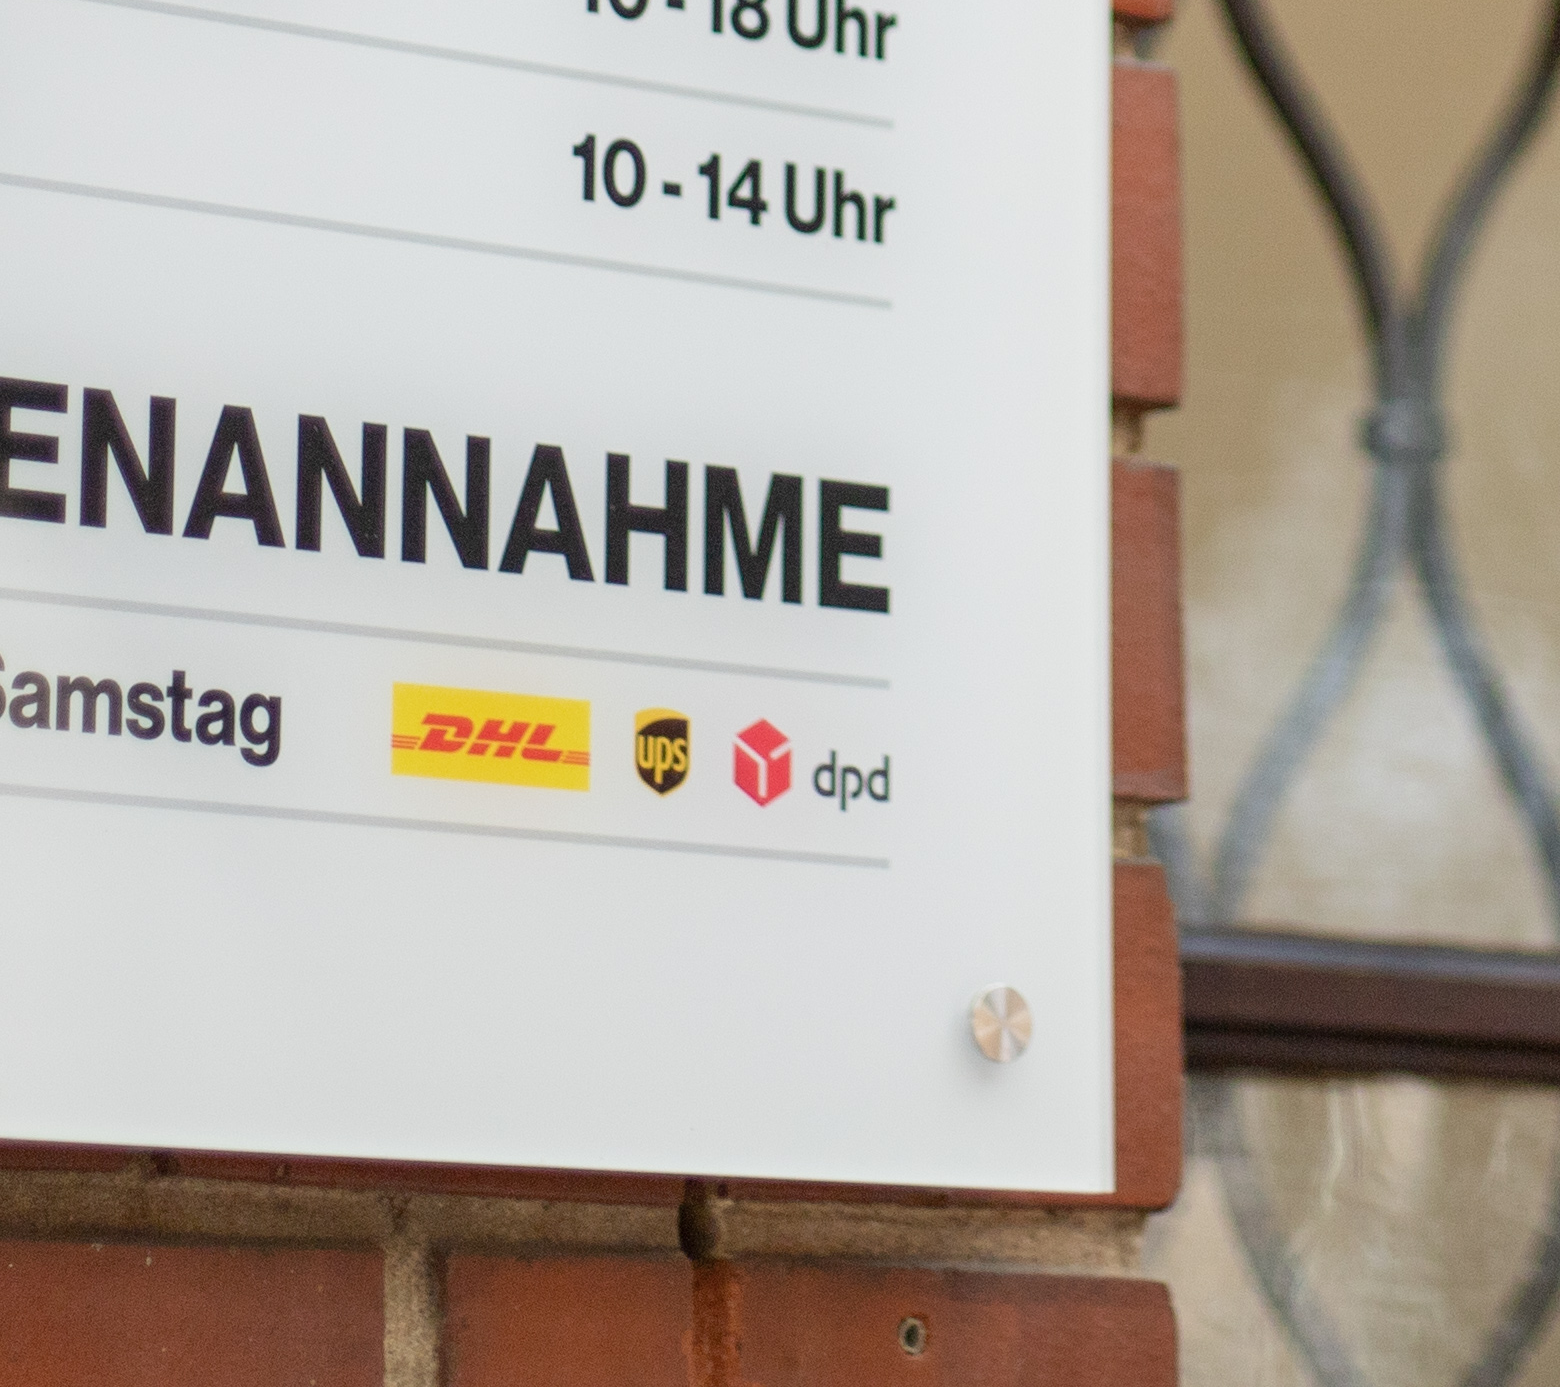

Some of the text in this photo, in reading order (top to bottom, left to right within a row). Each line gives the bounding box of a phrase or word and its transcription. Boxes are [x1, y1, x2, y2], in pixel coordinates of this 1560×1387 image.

[784, 163, 896, 244] Uhr
[418, 713, 564, 763] DHL
[638, 735, 688, 785] ups
[813, 750, 891, 812] dpd
